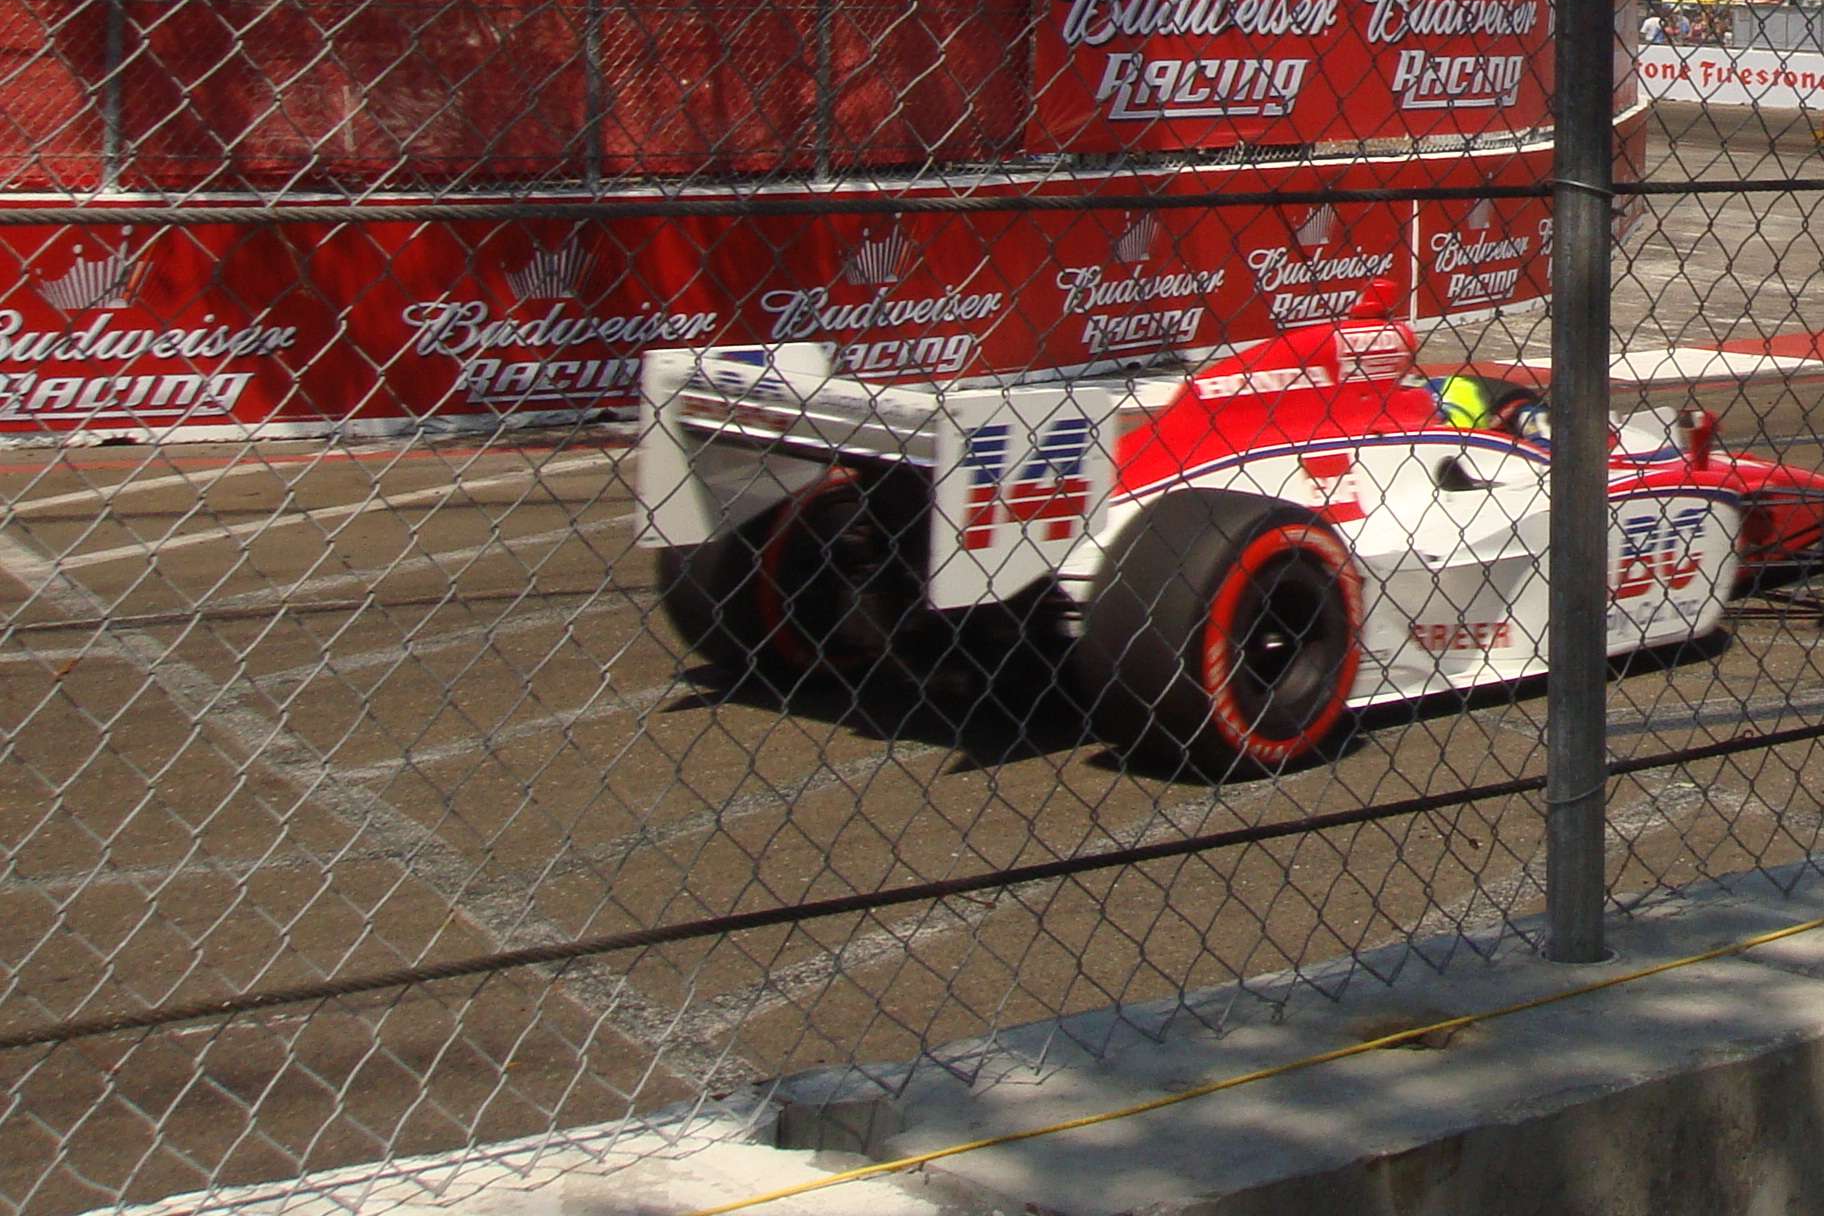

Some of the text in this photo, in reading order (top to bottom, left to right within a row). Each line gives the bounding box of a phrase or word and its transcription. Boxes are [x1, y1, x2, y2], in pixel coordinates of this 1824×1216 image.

[1248, 246, 1394, 291] Budweiser
[1431, 230, 1530, 273] Budweiser
[761, 286, 1003, 340] Budweiser
[1056, 264, 1225, 314] Budweiser
[1269, 290, 1363, 330] Racin
[0, 309, 298, 362] udweiser
[402, 300, 718, 357] Budweiser
[455, 358, 640, 404] Racin
[958, 418, 1094, 551] 14
[1608, 508, 1706, 600] BC
